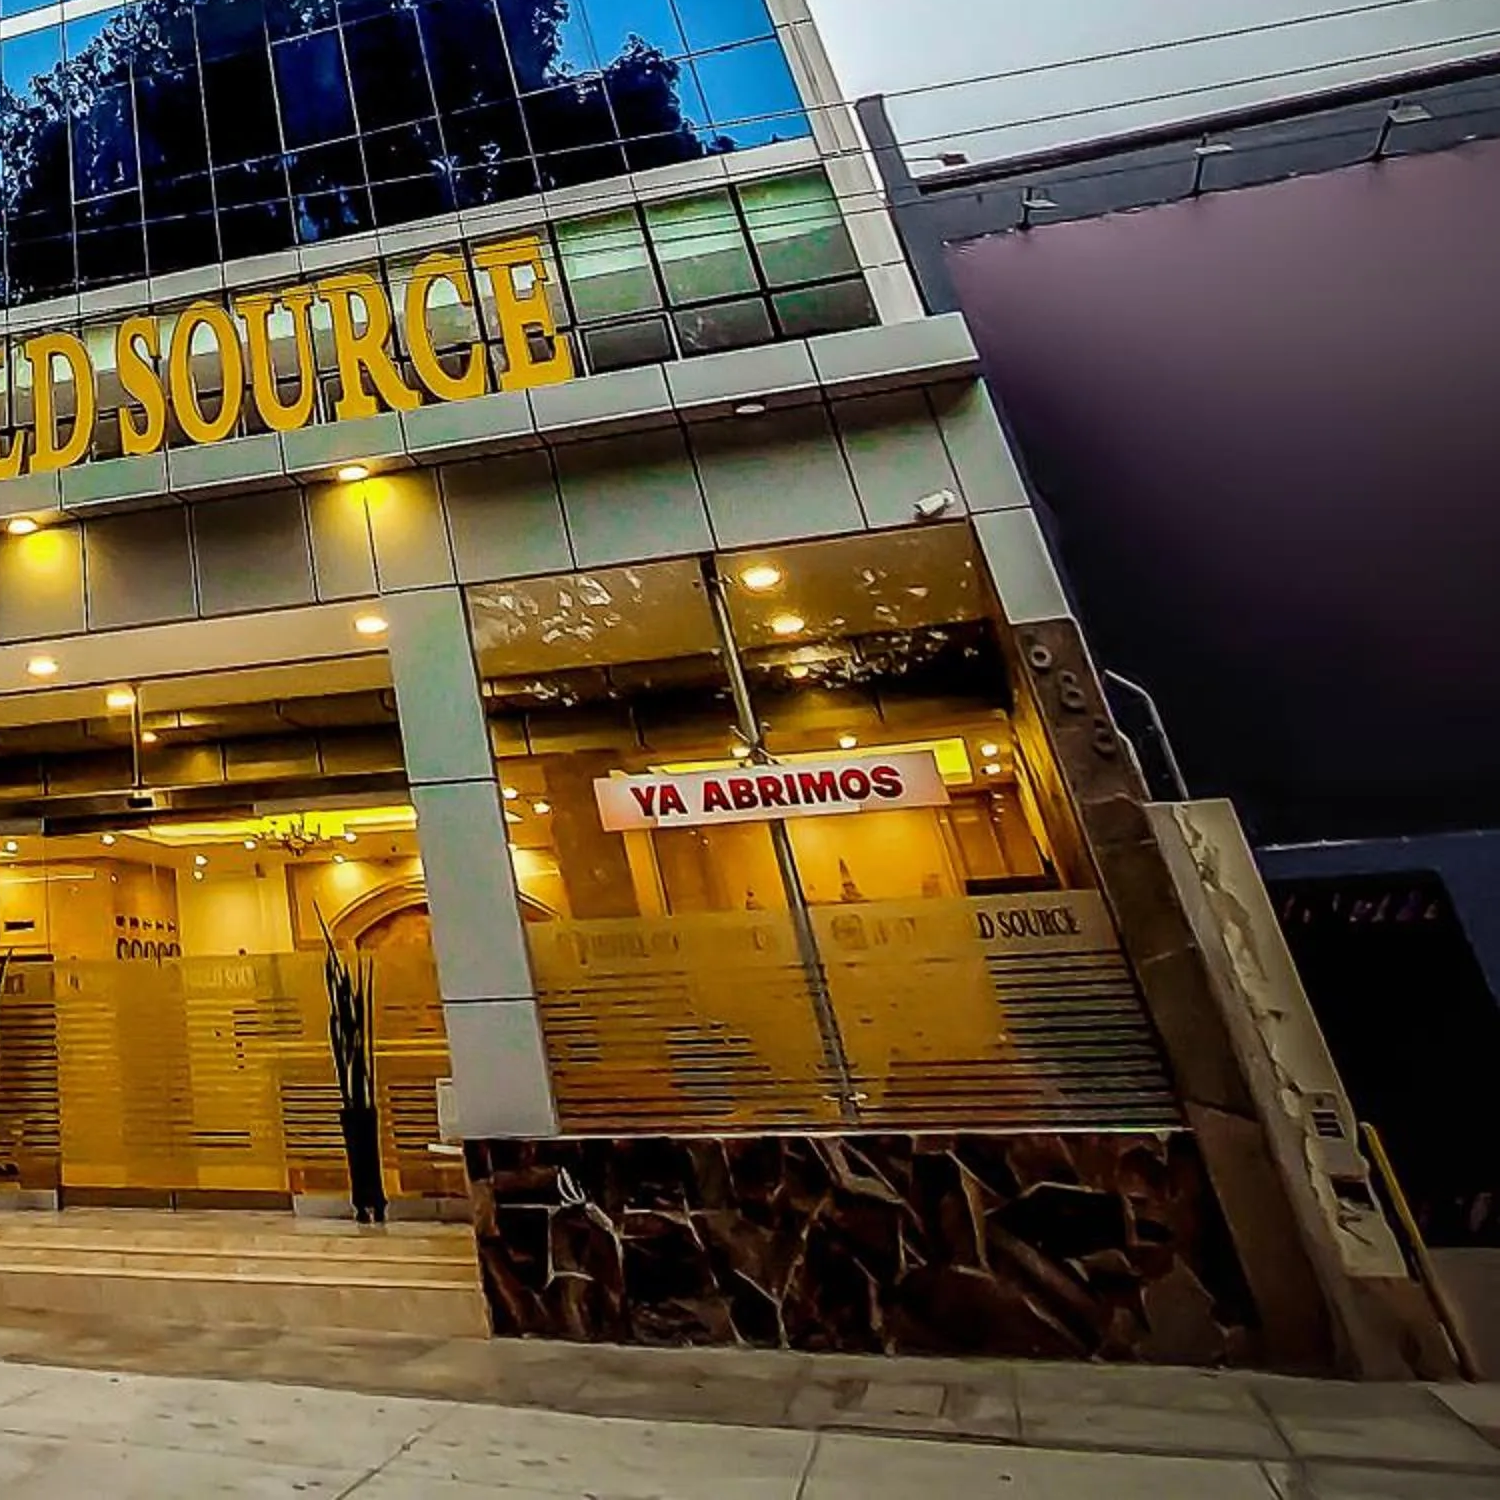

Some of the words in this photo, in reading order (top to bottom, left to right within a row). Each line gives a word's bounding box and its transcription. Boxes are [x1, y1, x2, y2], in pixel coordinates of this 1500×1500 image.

[116, 235, 575, 457] SOURCE
[630, 783, 689, 818] YA
[703, 765, 903, 813] ABRIMOS
